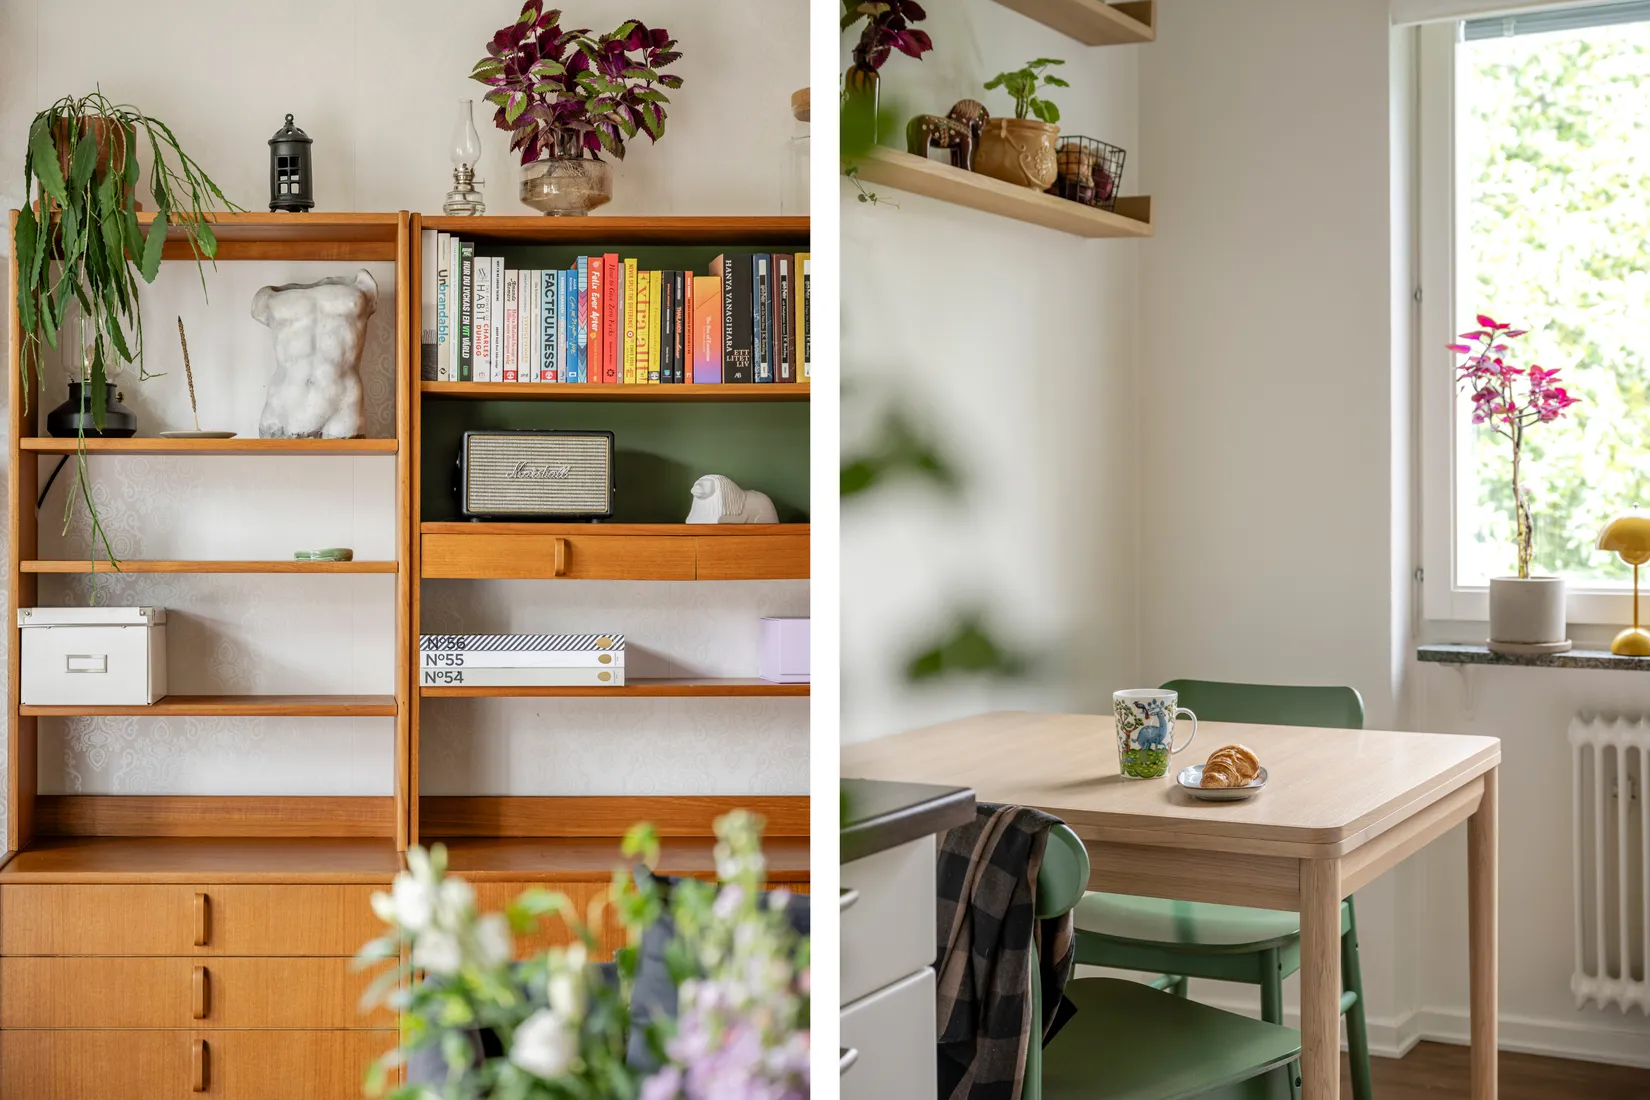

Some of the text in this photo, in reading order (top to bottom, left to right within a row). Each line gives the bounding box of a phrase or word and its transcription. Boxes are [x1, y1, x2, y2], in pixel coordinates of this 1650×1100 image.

[462, 260, 471, 275] HUR
[462, 275, 471, 286] DU
[462, 286, 471, 312] LYCKAS
[476, 284, 486, 321] HABIT
[462, 315, 471, 325] EN
[544, 273, 554, 368] FACTFULNESS
[590, 311, 600, 332] After
[462, 325, 471, 337] VIT
[462, 337, 471, 359] VÄRLD
[506, 460, 572, 479] Marshall
